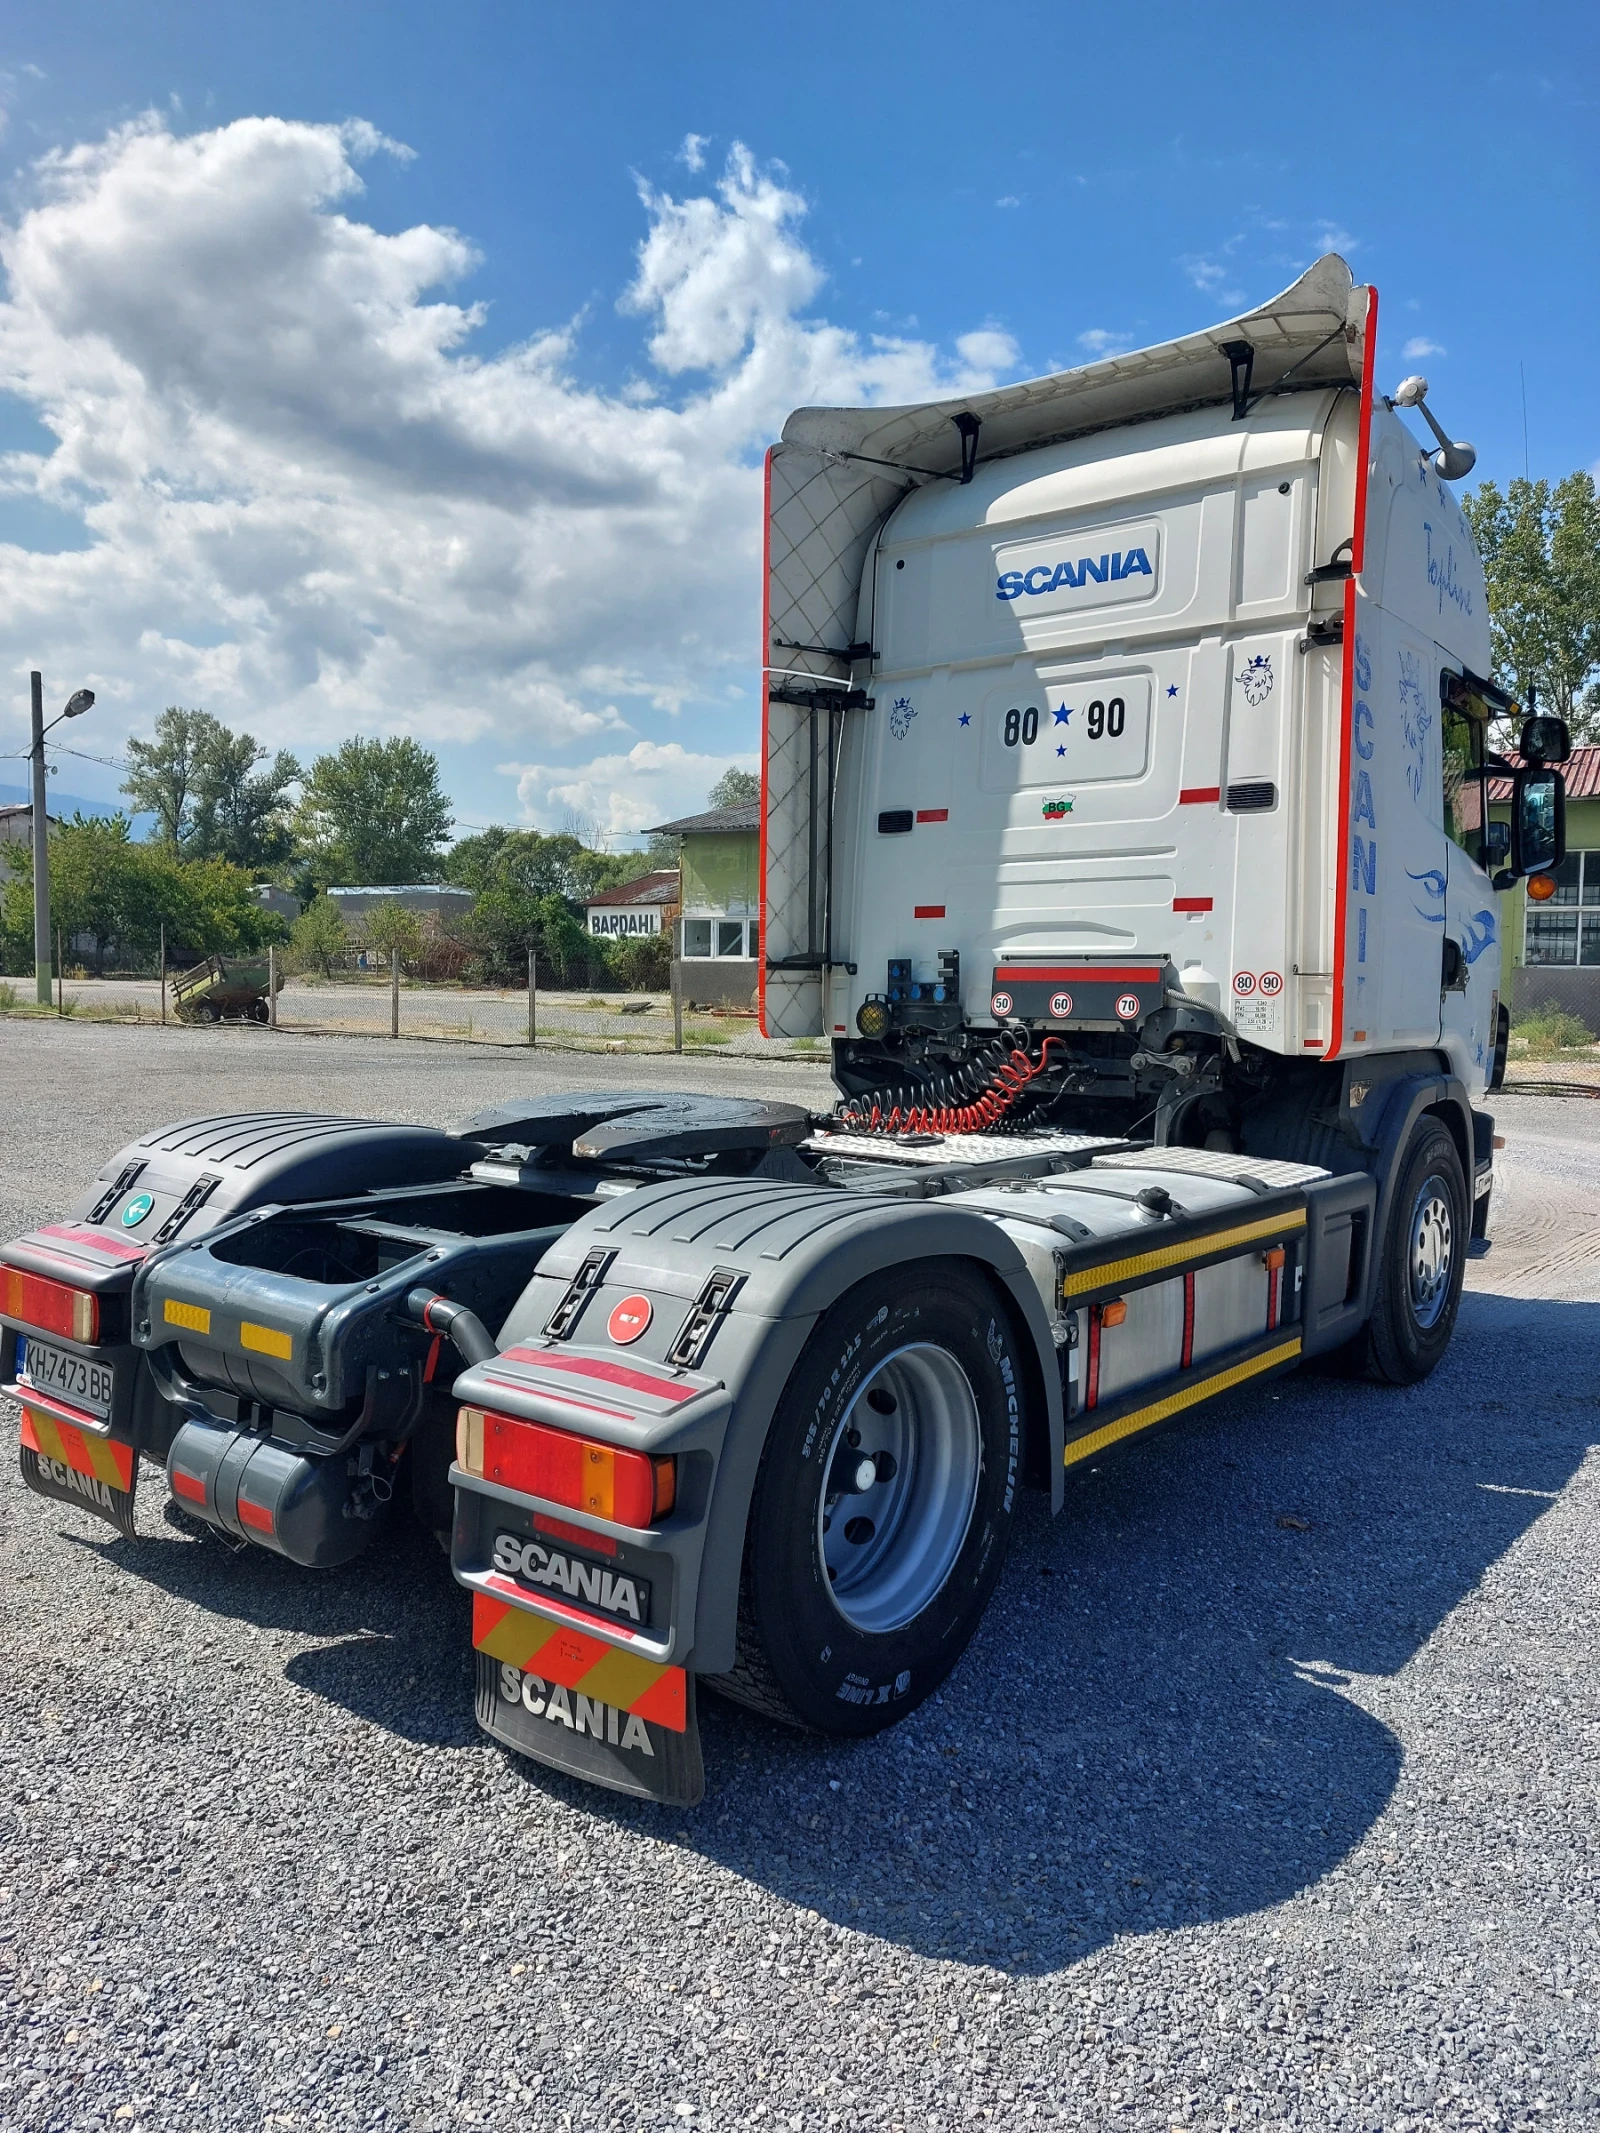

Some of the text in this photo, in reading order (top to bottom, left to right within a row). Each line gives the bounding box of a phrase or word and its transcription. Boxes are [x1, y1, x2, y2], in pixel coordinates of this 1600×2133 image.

[996, 548, 1152, 601] SCANIA
[1004, 707, 1039, 747] 80
[1087, 697, 1125, 739] 90
[1048, 802, 1066, 812] BG
[1353, 635, 1377, 1001] SCANI
[592, 914, 658, 936] BARDAHL
[1237, 976, 1252, 988] 80
[1263, 976, 1278, 988] 90
[995, 997, 1009, 1009] 50
[1054, 998, 1068, 1010] 60
[1121, 1000, 1135, 1012] 70
[48, 1352, 87, 1394] 7473
[1000, 1355, 1019, 1514] MICHELIN
[38, 1452, 115, 1513] SCANIA
[493, 1534, 641, 1621] SCANIA
[500, 1662, 655, 1757] SCANIA
[836, 1682, 875, 1705] LINE
